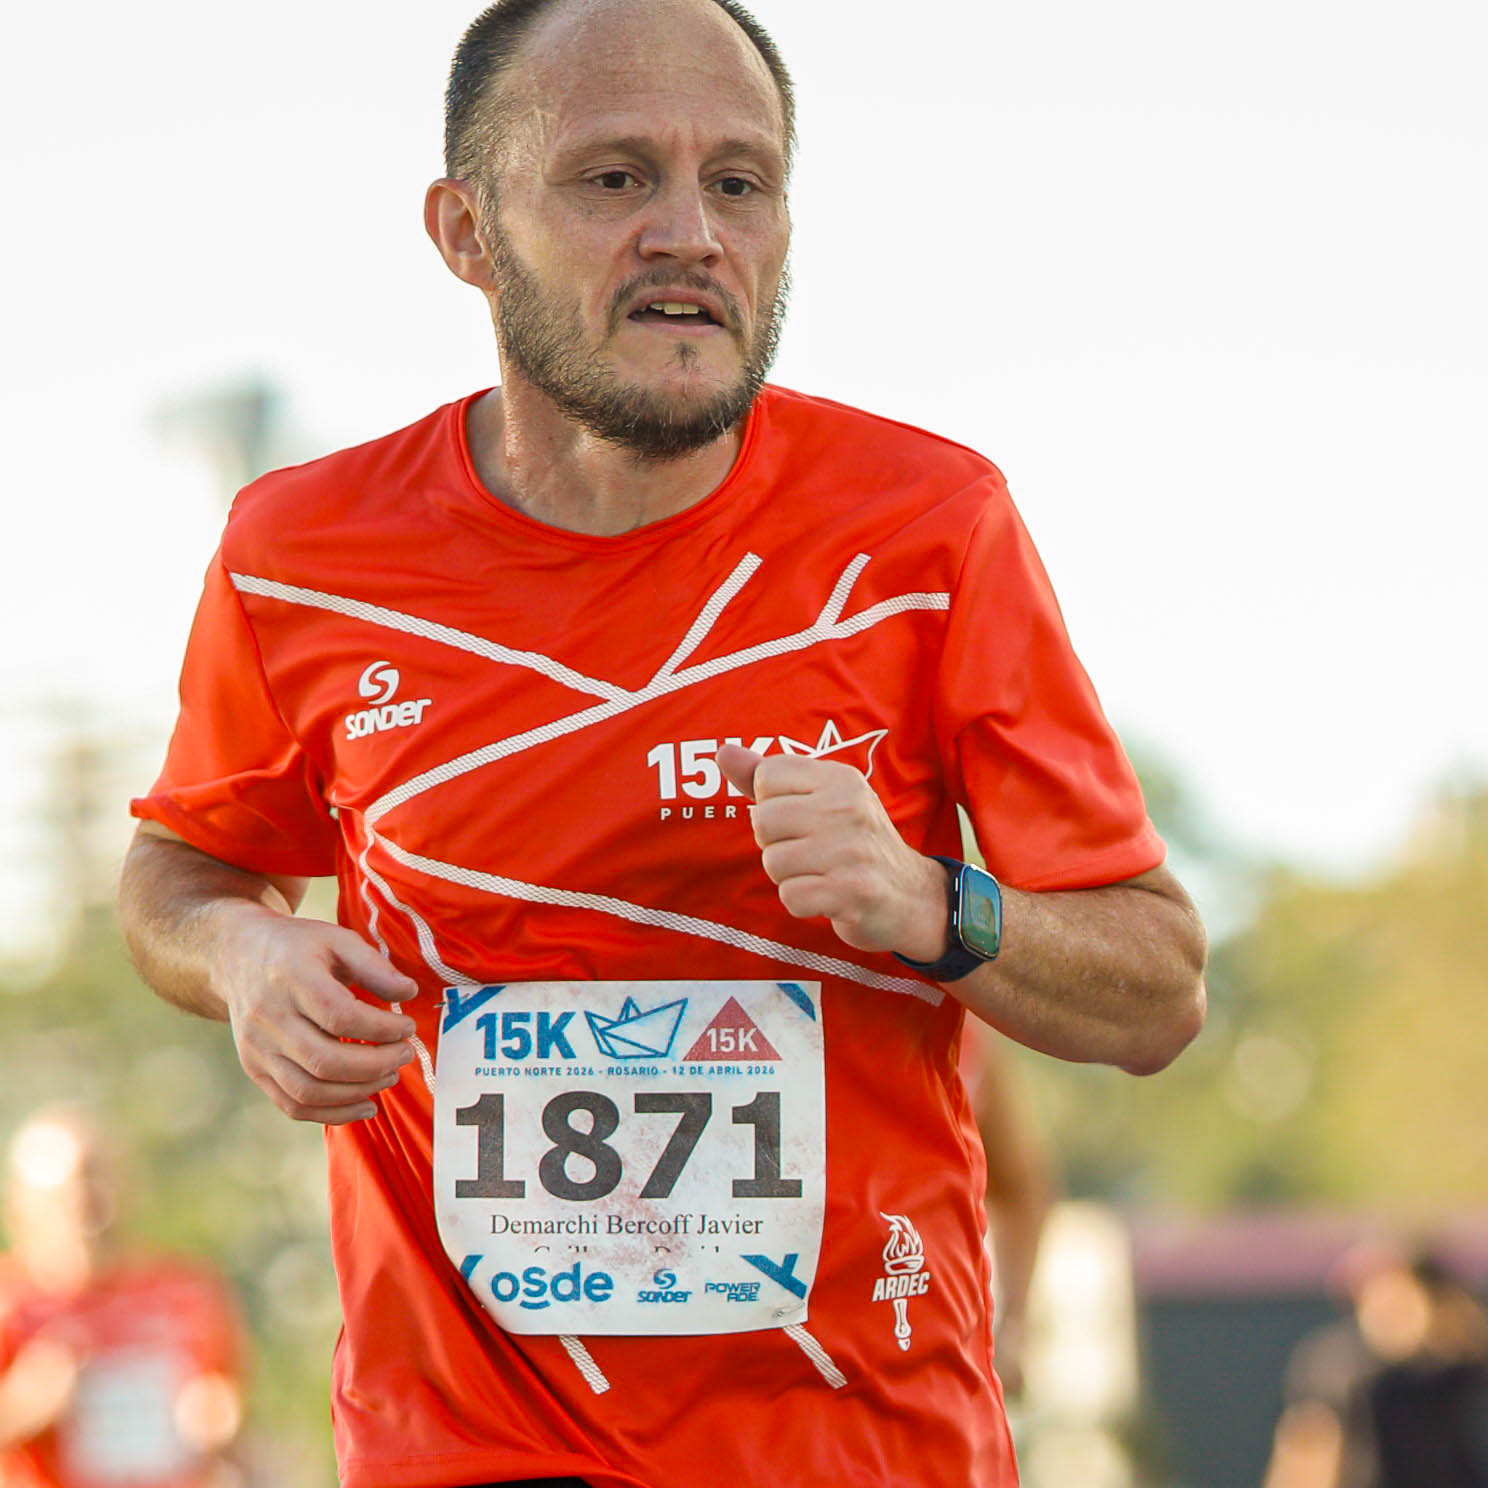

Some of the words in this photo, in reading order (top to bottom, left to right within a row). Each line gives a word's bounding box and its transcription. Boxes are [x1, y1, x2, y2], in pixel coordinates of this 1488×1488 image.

[474, 1010, 578, 1061] 15K
[705, 1026, 759, 1054] 15K
[474, 1066, 521, 1077] PUERTO
[524, 1066, 562, 1077] NORTE
[566, 1066, 594, 1076] 2026
[607, 1066, 658, 1076] ROSARIO
[672, 1065, 684, 1075] 12
[689, 1065, 704, 1075] DE
[710, 1065, 743, 1075] ABRIL
[747, 1065, 776, 1075] 2026
[454, 1090, 803, 1202] 1871
[490, 1213, 598, 1235] Demarchi
[606, 1213, 694, 1235] Bercoff
[696, 1214, 764, 1235] Javier
[490, 1260, 615, 1303] osde
[704, 1281, 761, 1293] POWER
[871, 1271, 931, 1302] ARDEC
